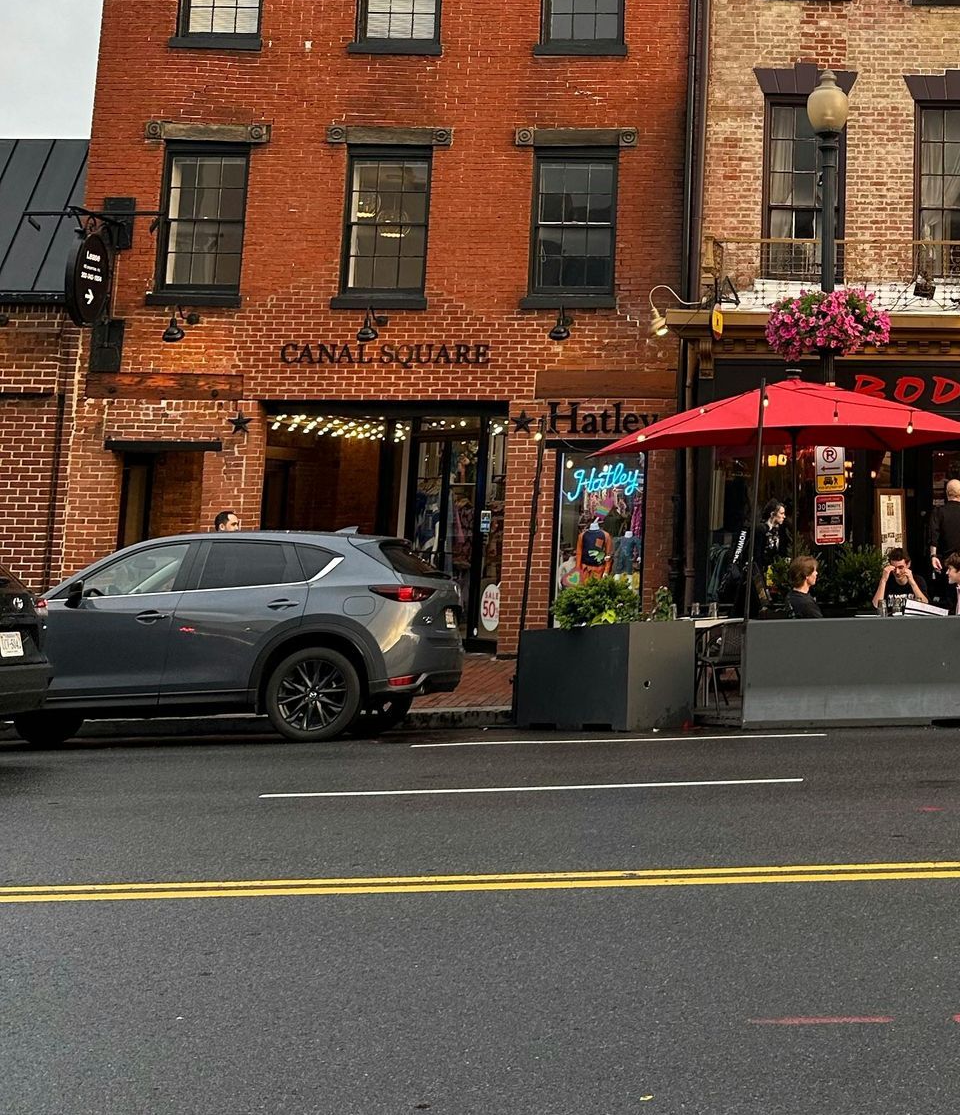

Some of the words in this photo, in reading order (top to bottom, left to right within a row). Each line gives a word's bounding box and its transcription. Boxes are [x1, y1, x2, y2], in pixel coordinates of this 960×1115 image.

[280, 343, 372, 365] CANAL
[379, 343, 490, 368] SQUARE
[567, 462, 639, 501] Hatley
